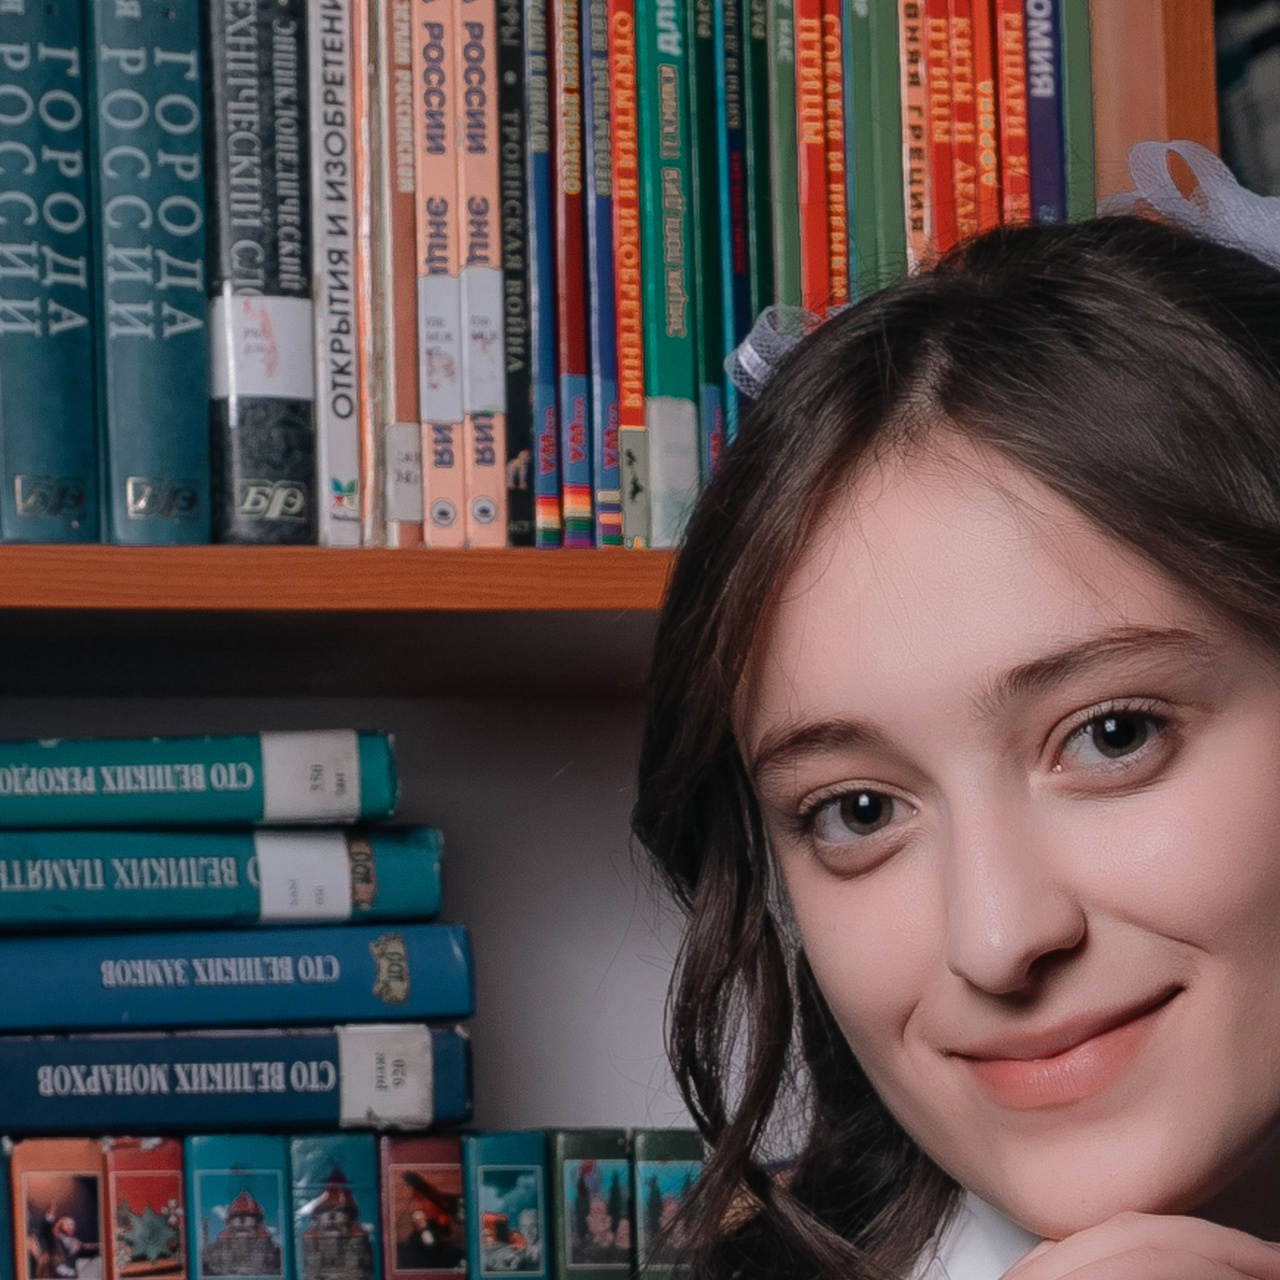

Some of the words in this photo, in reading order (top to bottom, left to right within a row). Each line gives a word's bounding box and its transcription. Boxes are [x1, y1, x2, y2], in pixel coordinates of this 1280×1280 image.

[423, 21, 447, 155] РОССИИ
[464, 21, 488, 155] РОССИИ
[611, 11, 638, 170] ОТКРЫТИЯ
[799, 18, 825, 144] ПТИЦЫ
[929, 18, 951, 144] ПТИЦЫ
[952, 16, 974, 104] КИТЫ
[1003, 12, 1027, 138] РЫЦАРИ
[0, 42, 42, 337] РОССИИ
[38, 42, 88, 336] ГОРОДА
[101, 43, 155, 340] РОССИИ
[153, 46, 204, 340] ГОРОДА
[272, 18, 308, 291] ЭНЦИКЛОПЕДИЧЕСКИЙ
[502, 109, 524, 270] ТРОЯНСКАЯ
[907, 103, 925, 232] ГРЕЦИЯ
[954, 122, 976, 144] И
[326, 213, 348, 243] И
[326, 249, 355, 420] ОТКРЫТИЯ
[506, 279, 528, 372] ВОЙНА
[618, 207, 644, 408] ИЗОБРЕТЕНИЯ
[100, 762, 202, 793] ВЕЛИКИХ
[211, 762, 256, 791] СТО
[110, 857, 239, 890] ВЕЛИКИХ
[101, 958, 191, 989] ЗАМКОВ
[193, 956, 295, 986] ВЕЛИКИХ
[298, 955, 341, 983] СТО
[37, 1063, 170, 1098] МОНАРХОВ
[174, 1062, 287, 1095] ВЕЛИКИХ
[290, 1060, 338, 1092] СТО
